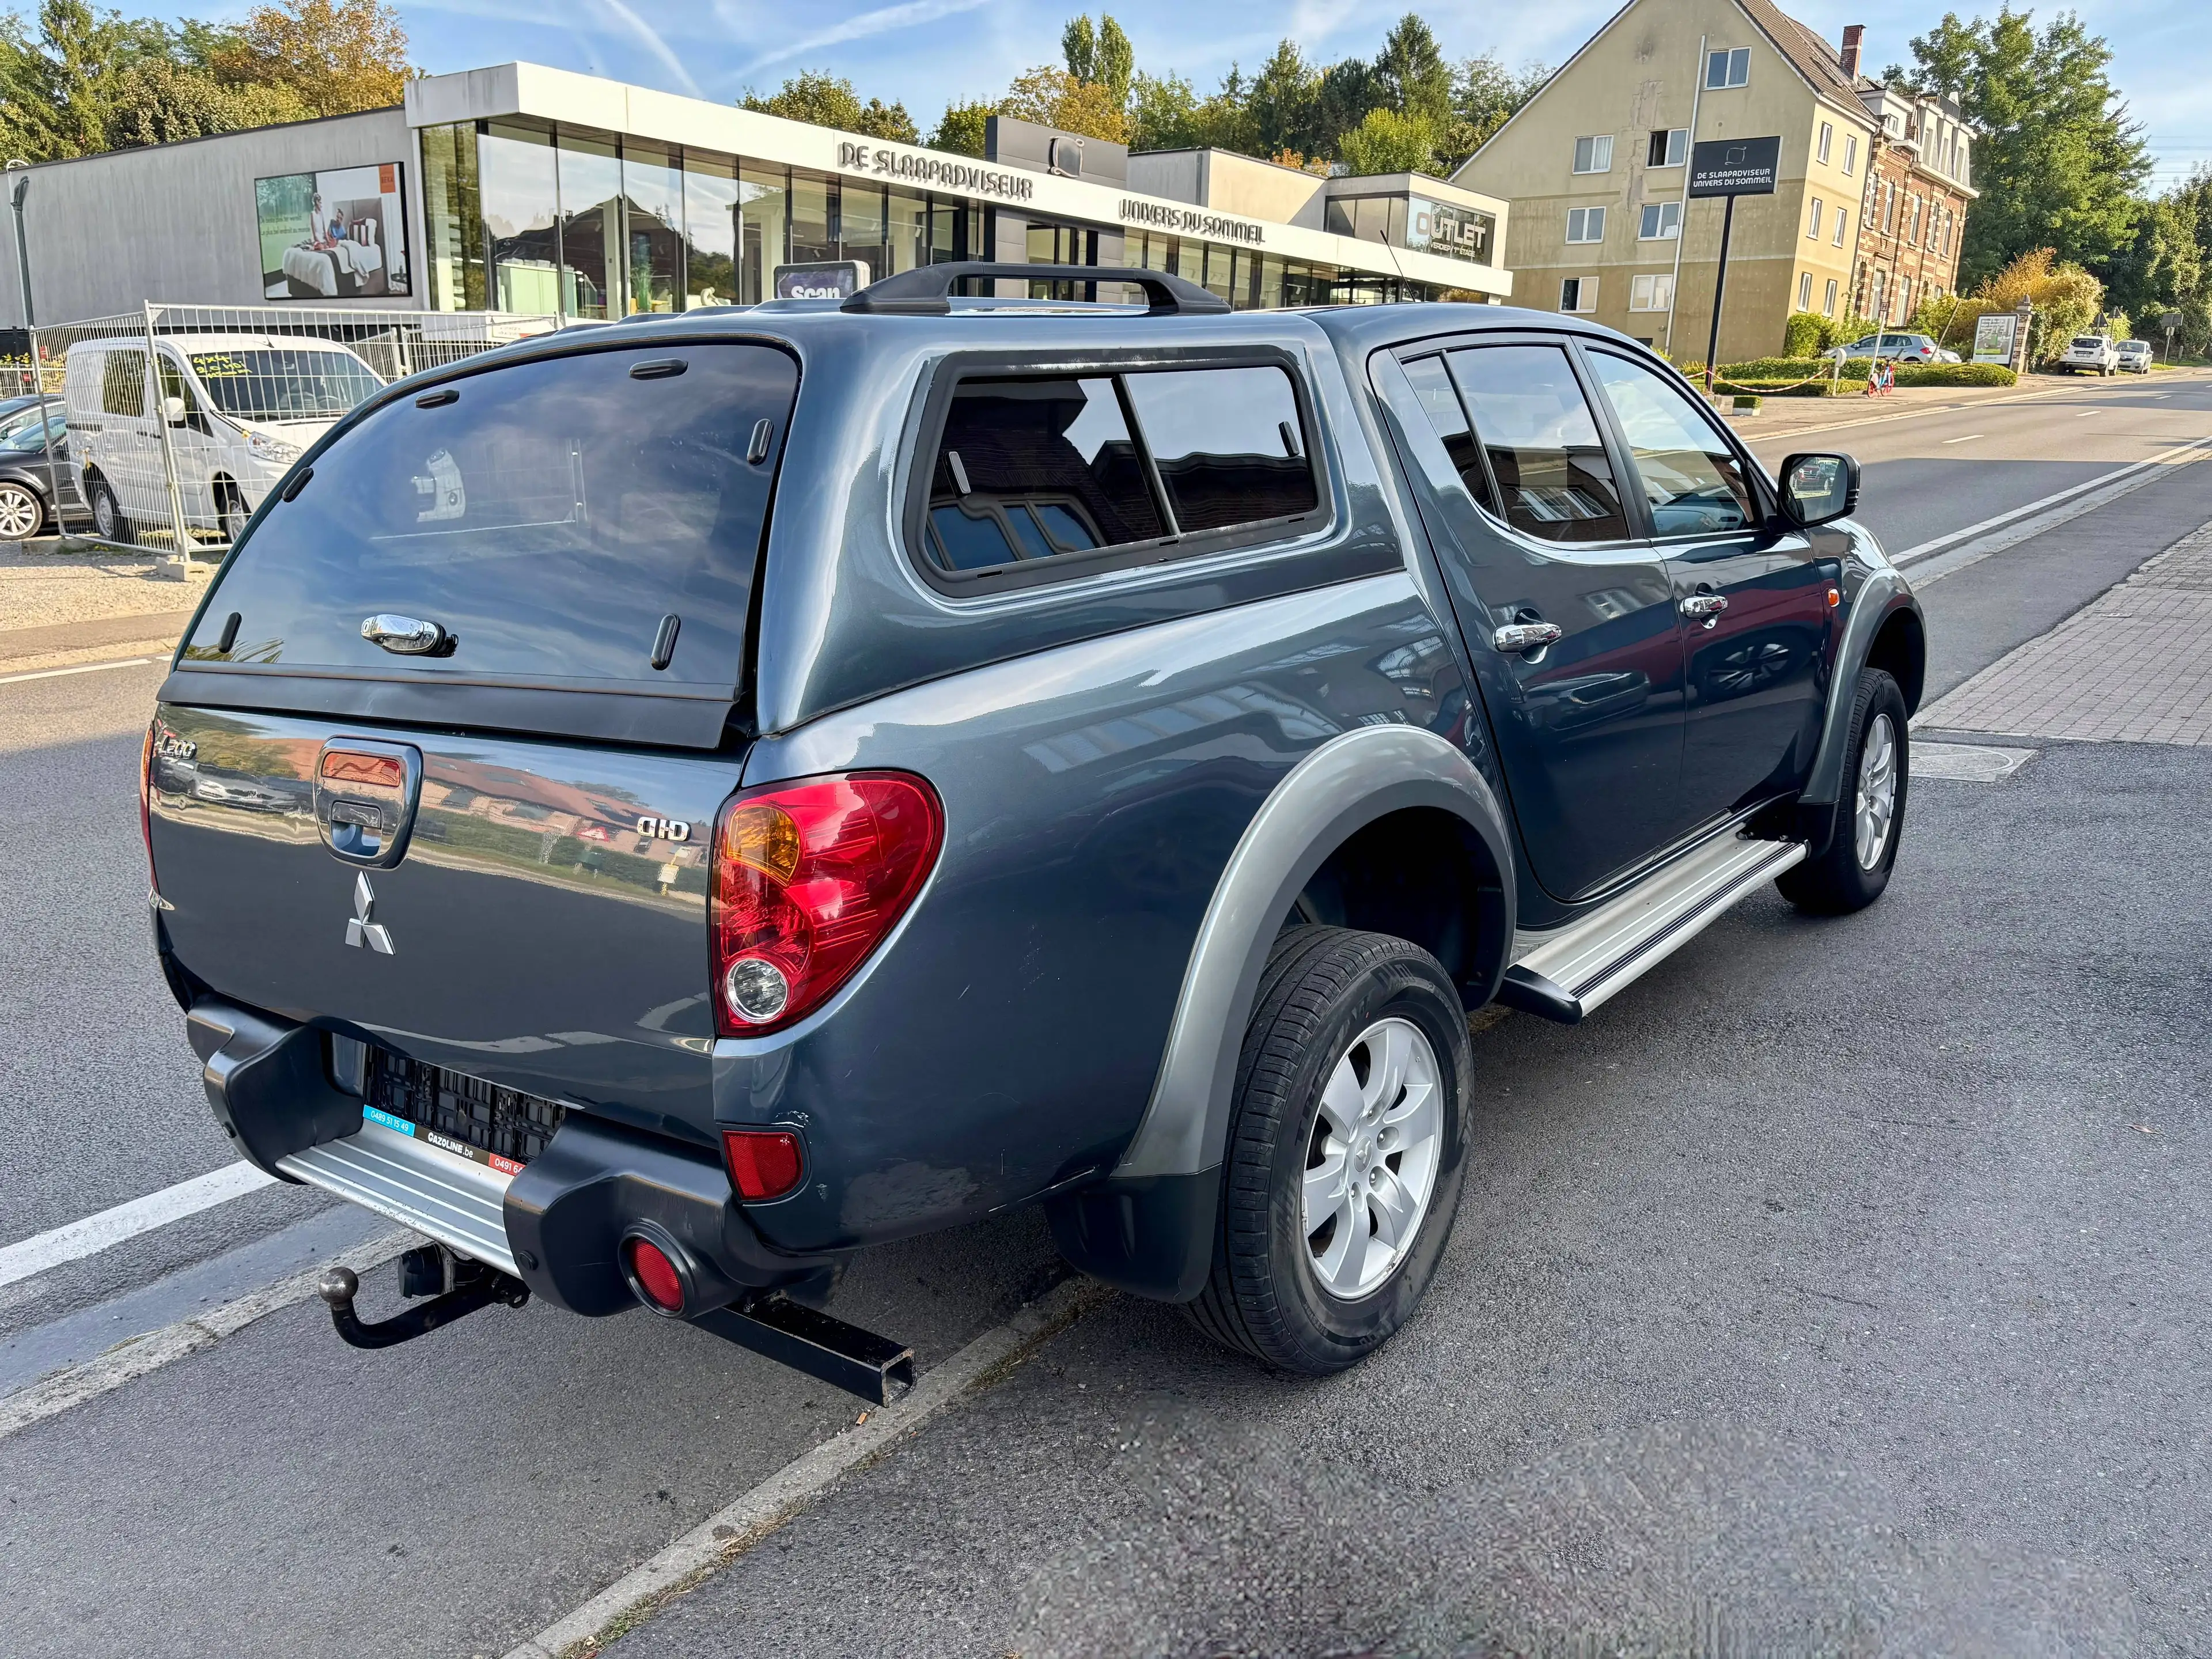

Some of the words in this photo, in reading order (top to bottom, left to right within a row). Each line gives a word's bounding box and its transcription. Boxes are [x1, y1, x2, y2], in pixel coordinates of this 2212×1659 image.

[842, 142, 869, 168] DE
[876, 149, 1033, 199] SLAAPADVISEUR
[1693, 179, 1723, 188] UNIVERS
[1735, 176, 1772, 185] SOMMEIL
[1709, 168, 1770, 179] SLAAPADVISEUR
[1123, 199, 1180, 226] UNIVERS
[1184, 211, 1202, 230] DU
[1203, 216, 1266, 243] SOMMEIL
[1416, 211, 1486, 248] OUTLET
[370, 1110, 386, 1123] 0489
[387, 1116, 393, 1125] 51
[393, 1119, 400, 1128] 15
[401, 1122, 409, 1132] 49
[427, 1132, 474, 1158] GAZOLINE.be
[495, 1158, 512, 1171] 0491
